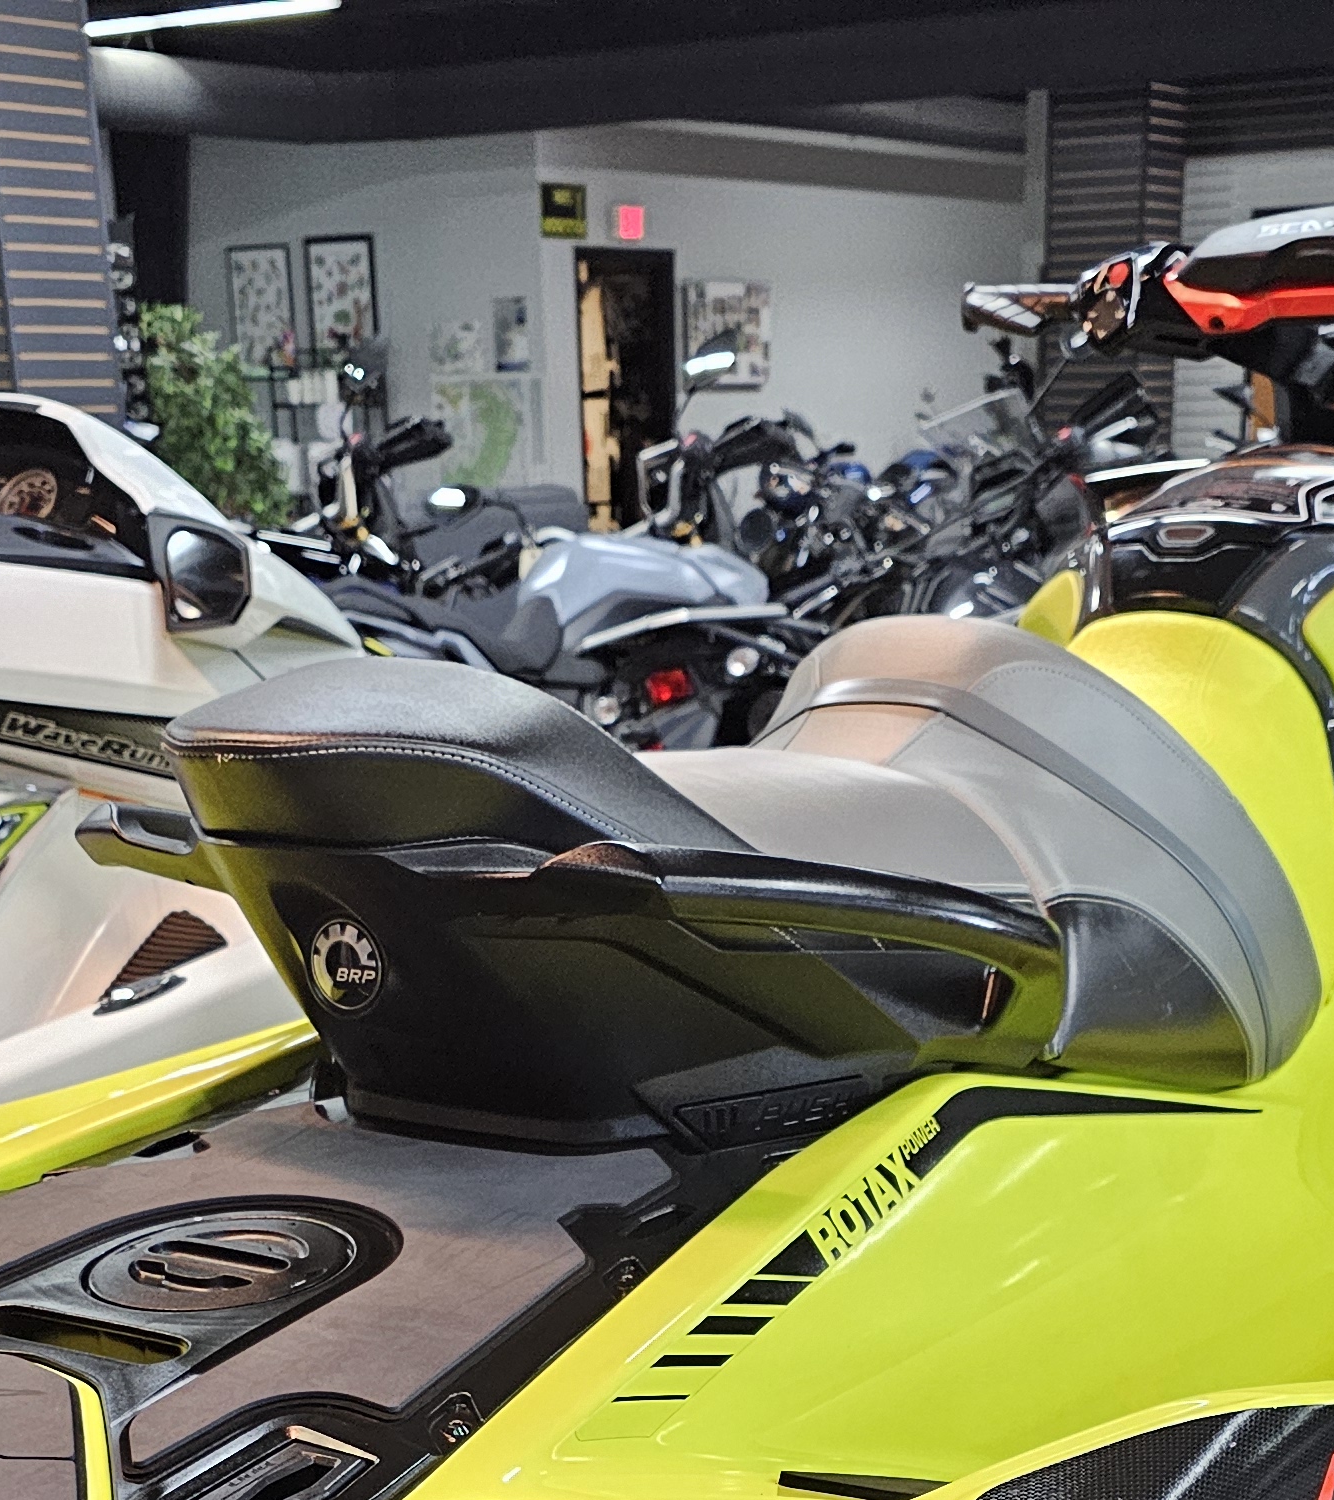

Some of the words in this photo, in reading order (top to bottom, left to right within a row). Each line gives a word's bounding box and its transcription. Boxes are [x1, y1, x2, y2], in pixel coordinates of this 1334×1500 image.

[336, 967, 376, 983] BRP
[807, 1146, 921, 1265] ROTAX
[901, 1116, 941, 1160] POWER
